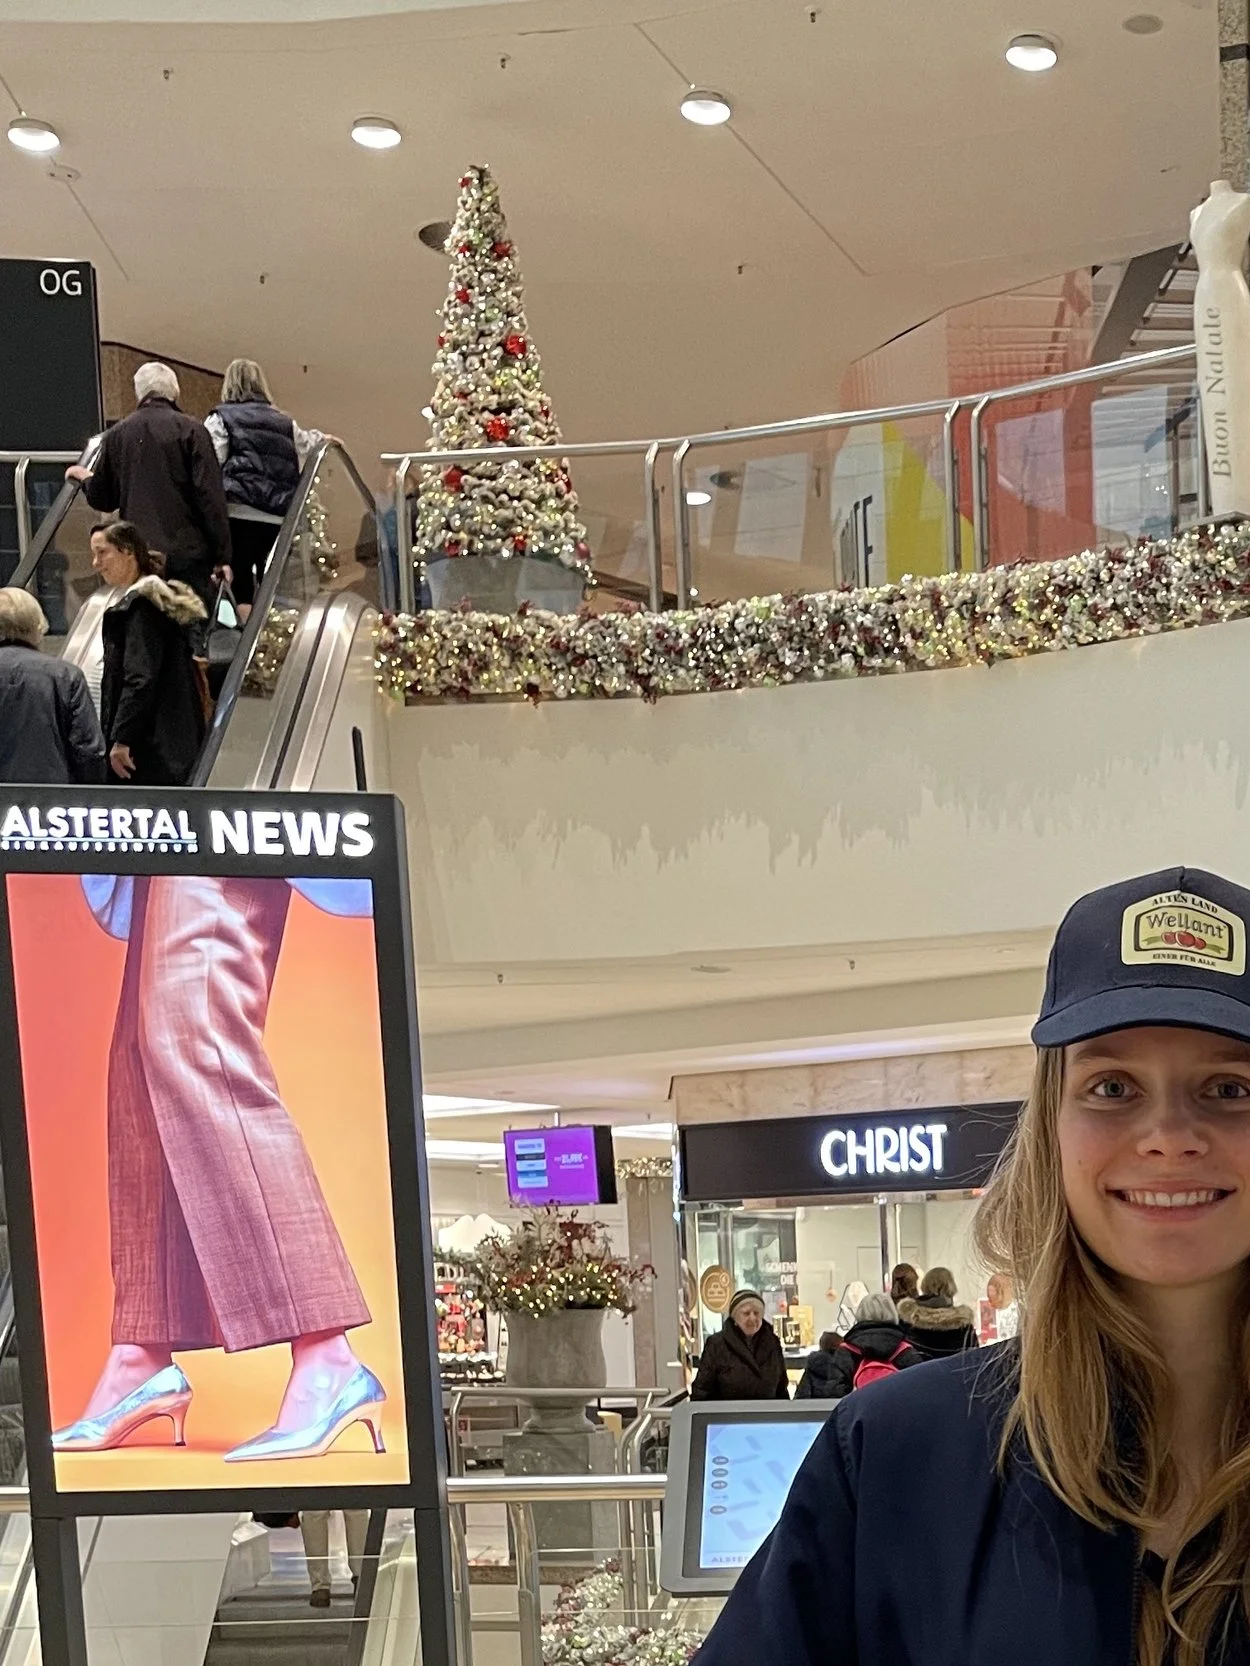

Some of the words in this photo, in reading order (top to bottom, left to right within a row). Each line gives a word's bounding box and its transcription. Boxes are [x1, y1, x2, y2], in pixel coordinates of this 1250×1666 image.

[40, 268, 82, 296] OG
[1212, 411, 1232, 479] Buon
[1, 805, 197, 839] ALSTERTAL
[210, 810, 374, 857] NEWS
[1152, 893, 1188, 906] ALTEN
[1191, 897, 1218, 914] LAND
[1146, 911, 1224, 939] Wellant
[820, 1123, 948, 1177] CHRIST
